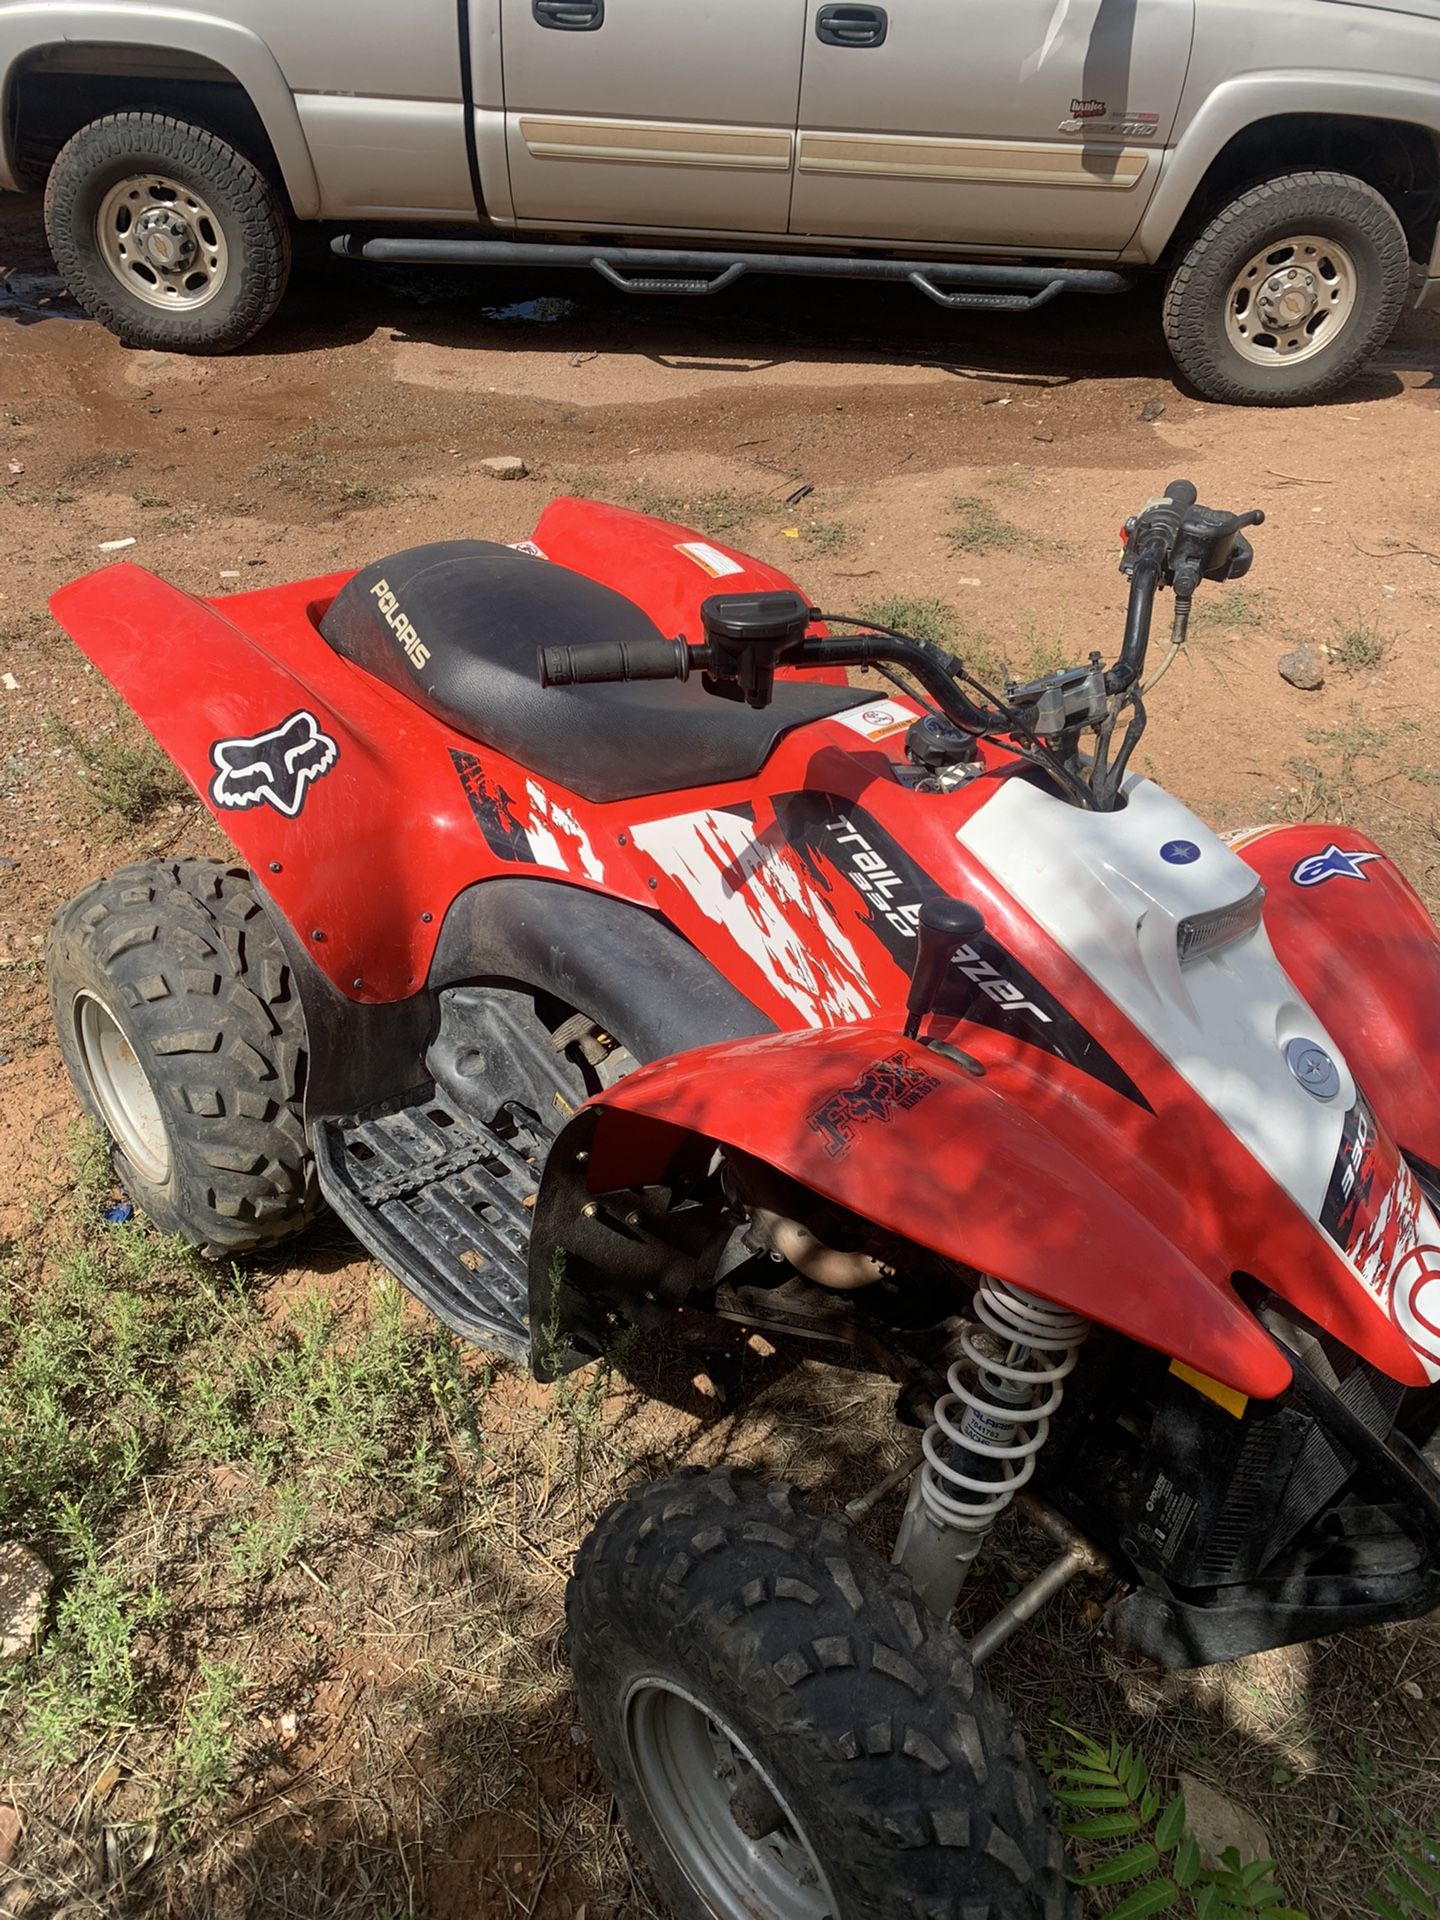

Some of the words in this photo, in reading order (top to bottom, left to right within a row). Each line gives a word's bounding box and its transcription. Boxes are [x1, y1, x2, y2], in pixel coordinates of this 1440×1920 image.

[370, 578, 431, 670] POLARIS
[848, 872, 917, 937] 330
[1341, 1111, 1367, 1202] 330
[971, 1407, 1015, 1430] OLARIS
